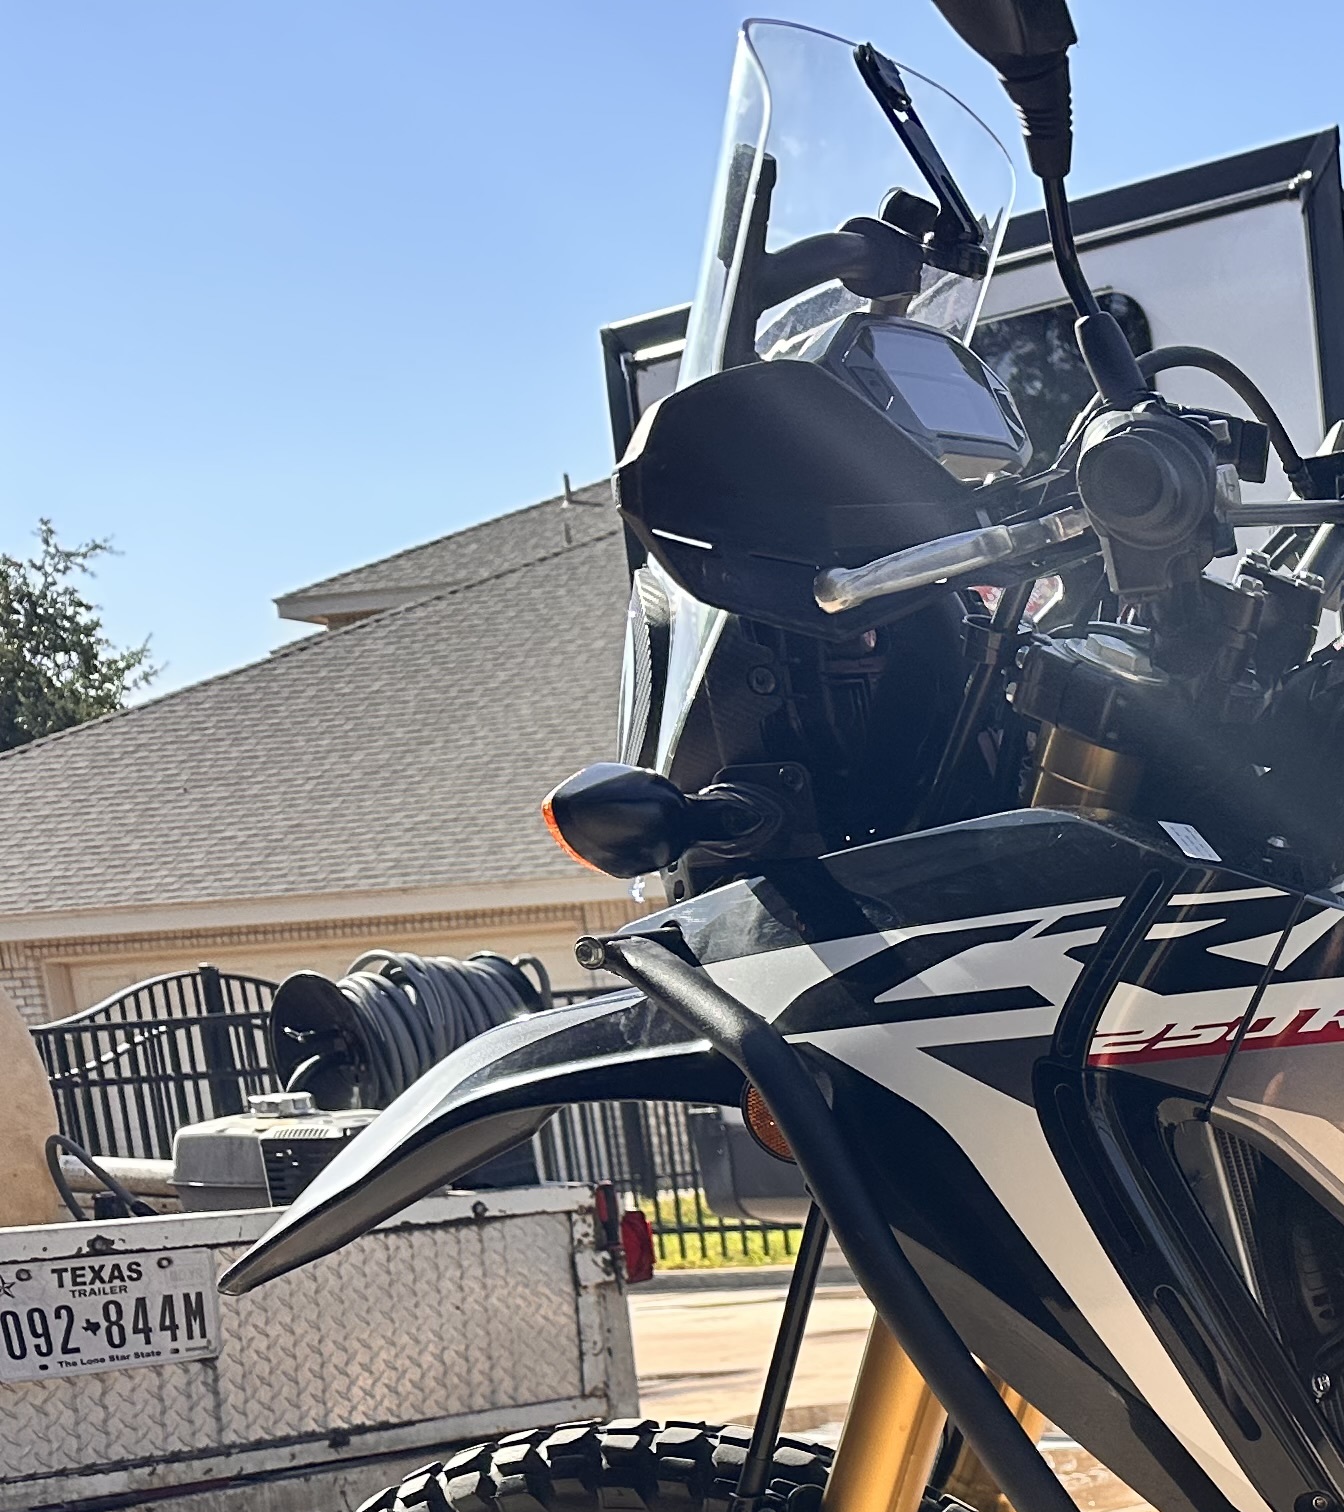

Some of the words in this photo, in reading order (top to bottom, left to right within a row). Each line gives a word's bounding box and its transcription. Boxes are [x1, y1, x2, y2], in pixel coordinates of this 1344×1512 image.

[51, 1261, 143, 1289] TEXAS
[69, 1284, 129, 1299] TRAILER
[57, 1360, 78, 1369] The
[80, 1356, 106, 1366] Lone
[108, 1353, 131, 1362] Star
[133, 1350, 162, 1359] State
